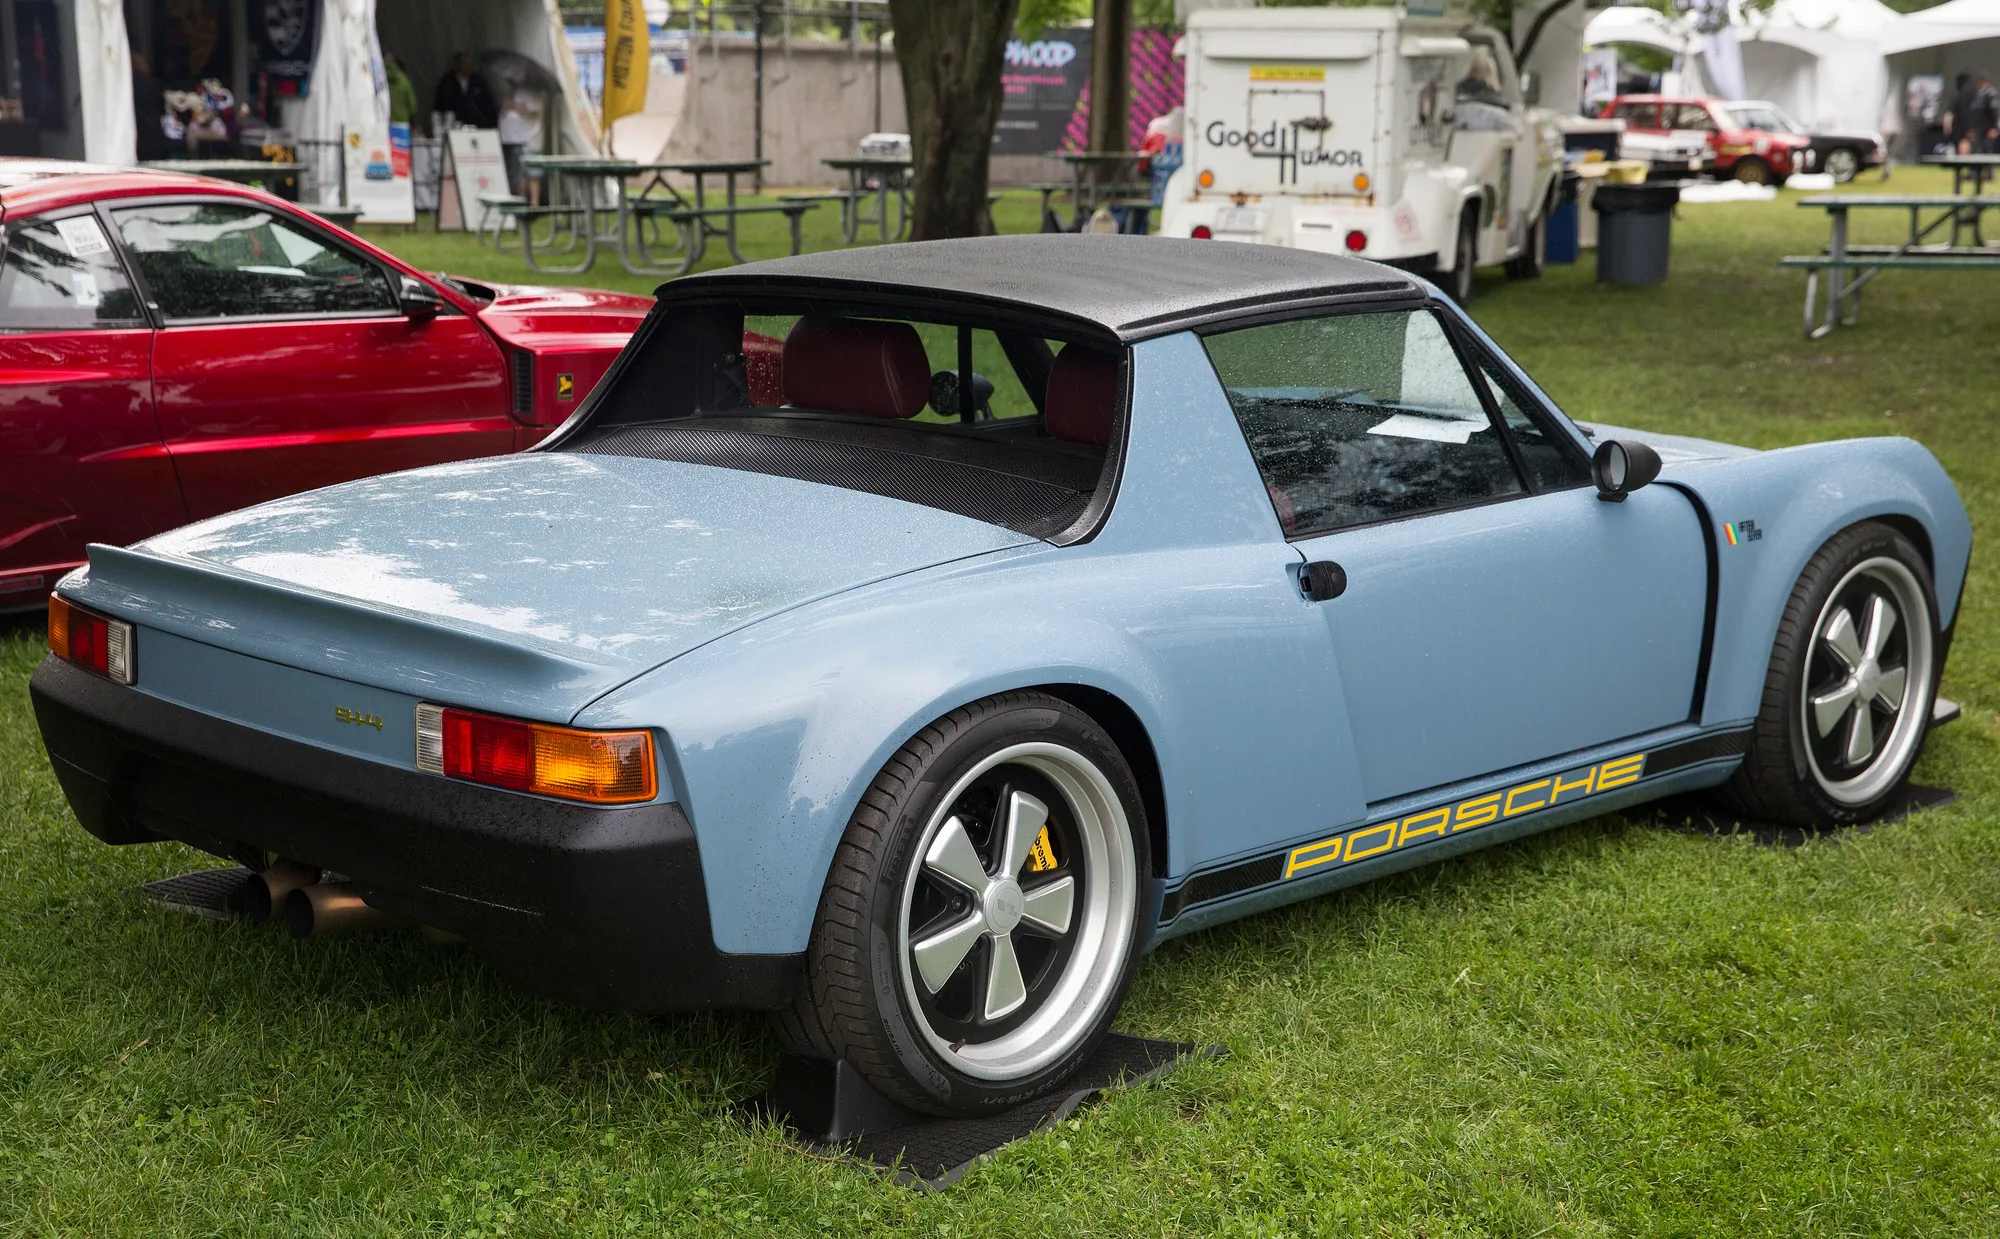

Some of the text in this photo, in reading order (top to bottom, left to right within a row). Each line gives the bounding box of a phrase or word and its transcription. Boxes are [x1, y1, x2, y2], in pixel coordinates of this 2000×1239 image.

[1206, 120, 1277, 147] Good
[335, 706, 383, 732] 914
[1284, 753, 1645, 879] PORSCHE
